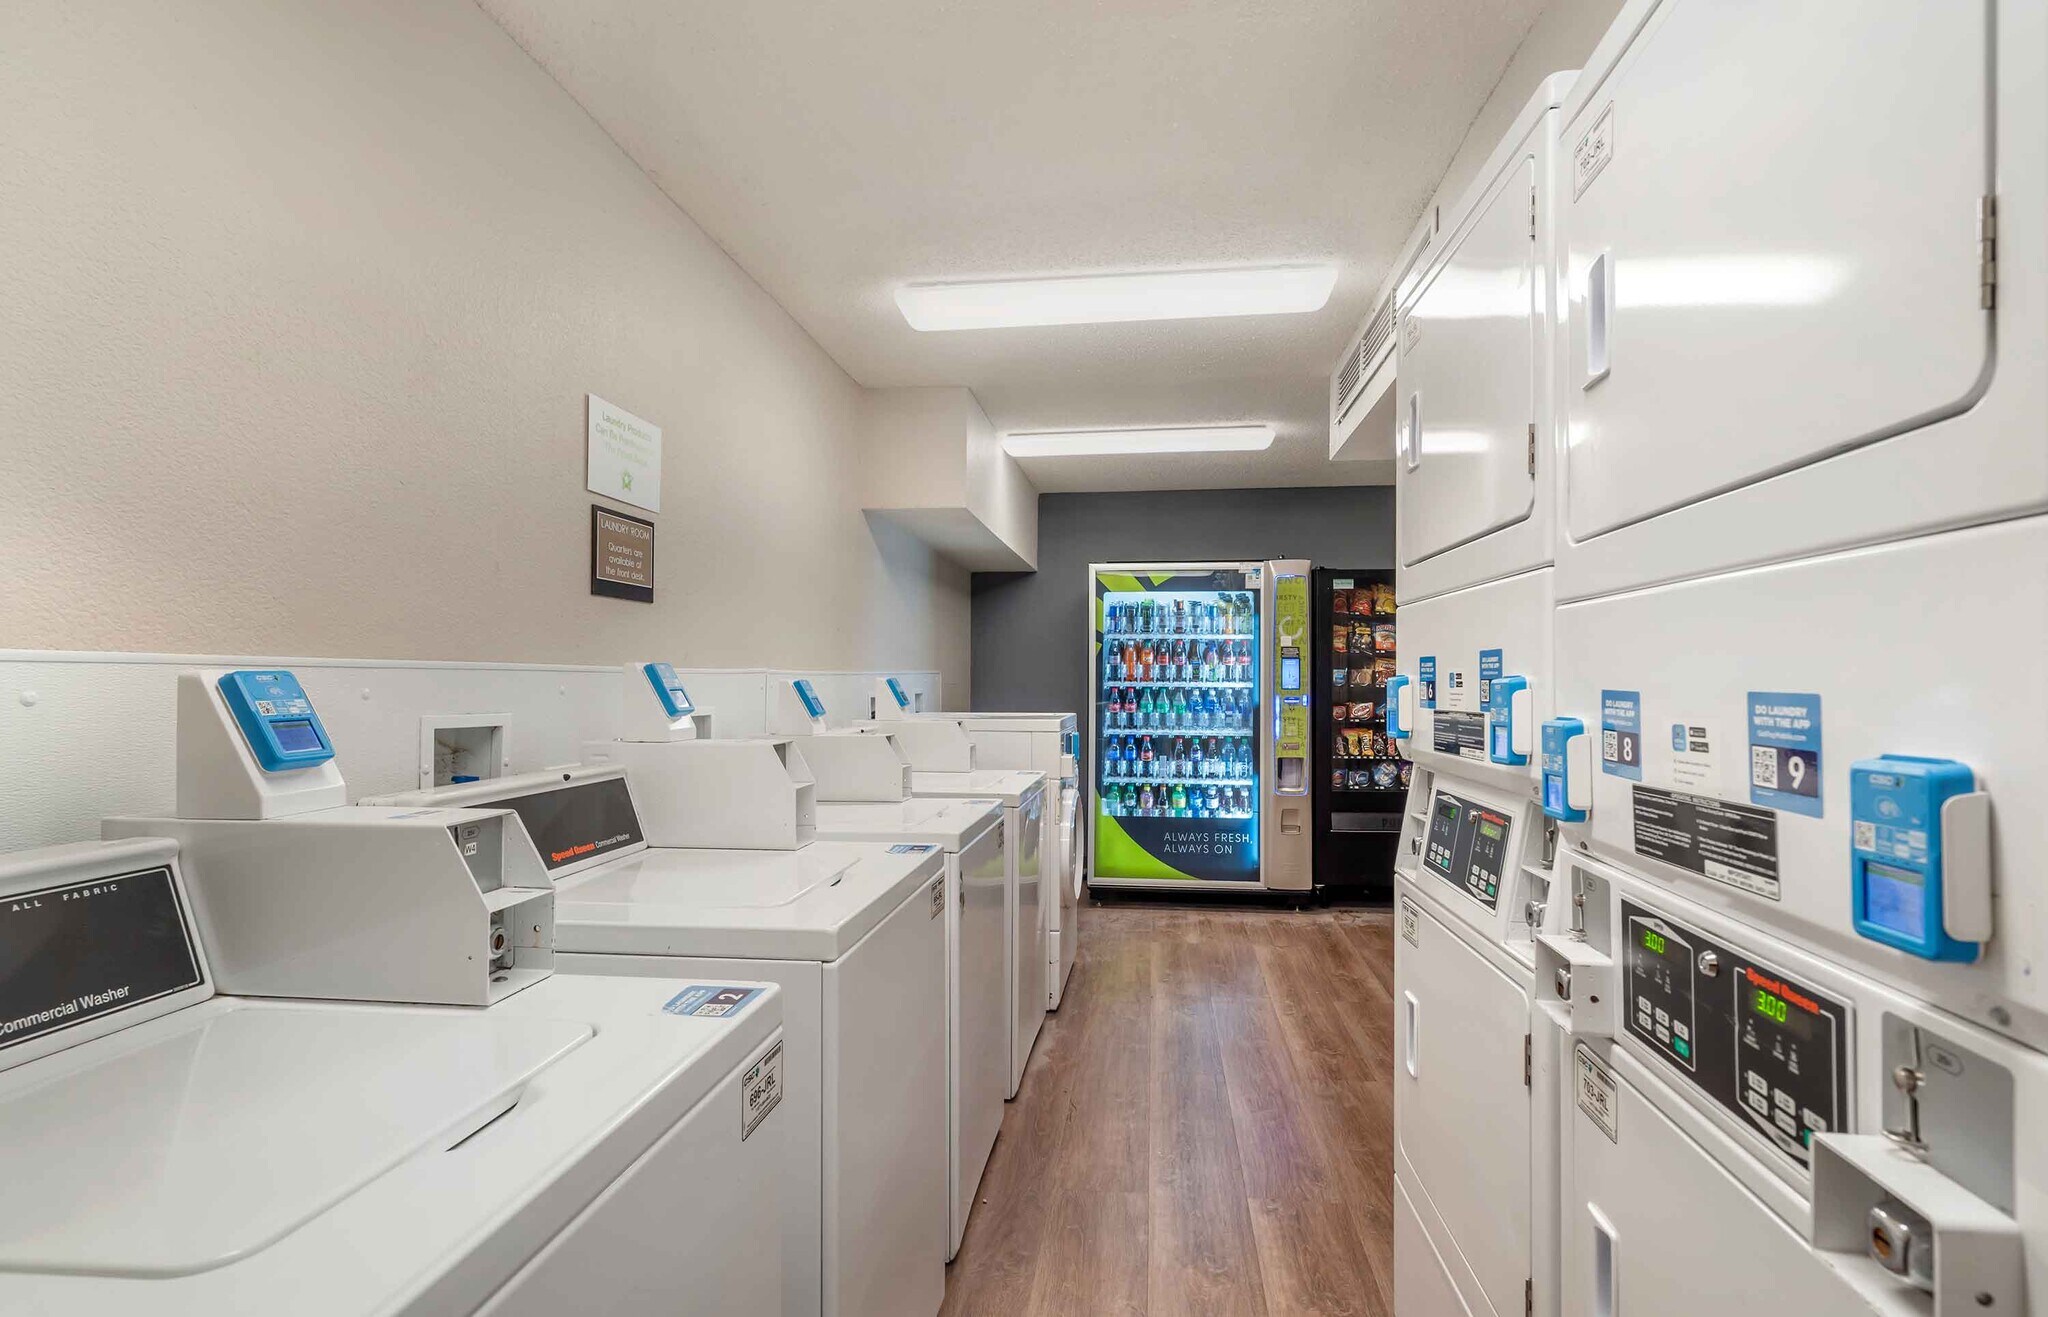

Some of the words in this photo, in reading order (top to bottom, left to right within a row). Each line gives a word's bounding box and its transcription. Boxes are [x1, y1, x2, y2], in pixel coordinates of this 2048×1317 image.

[600, 518, 628, 534] LAUNDRY
[630, 527, 650, 540] ROOM
[608, 542, 632, 556] Quarters
[608, 556, 635, 568] available
[605, 566, 616, 576] the
[617, 568, 630, 578] front
[1428, 683, 1434, 699] 6
[1755, 705, 1767, 715] DO
[1768, 706, 1808, 717] LAUNDRY
[1753, 716, 1774, 727] WITH
[1775, 717, 1792, 728] THE
[1792, 719, 1811, 730] APP
[1623, 736, 1633, 762] 8
[1788, 755, 1805, 790] 9
[1163, 832, 1209, 842] ALWAYS
[1214, 833, 1253, 844] FRESH,
[1163, 844, 1209, 854] ALWAYS
[1214, 845, 1232, 854] ON
[12, 900, 42, 912] ALL
[62, 884, 119, 901] FABRIC
[79, 985, 130, 1010] Washer
[718, 993, 744, 1001] 2
[750, 1073, 776, 1107] 696-JRL
